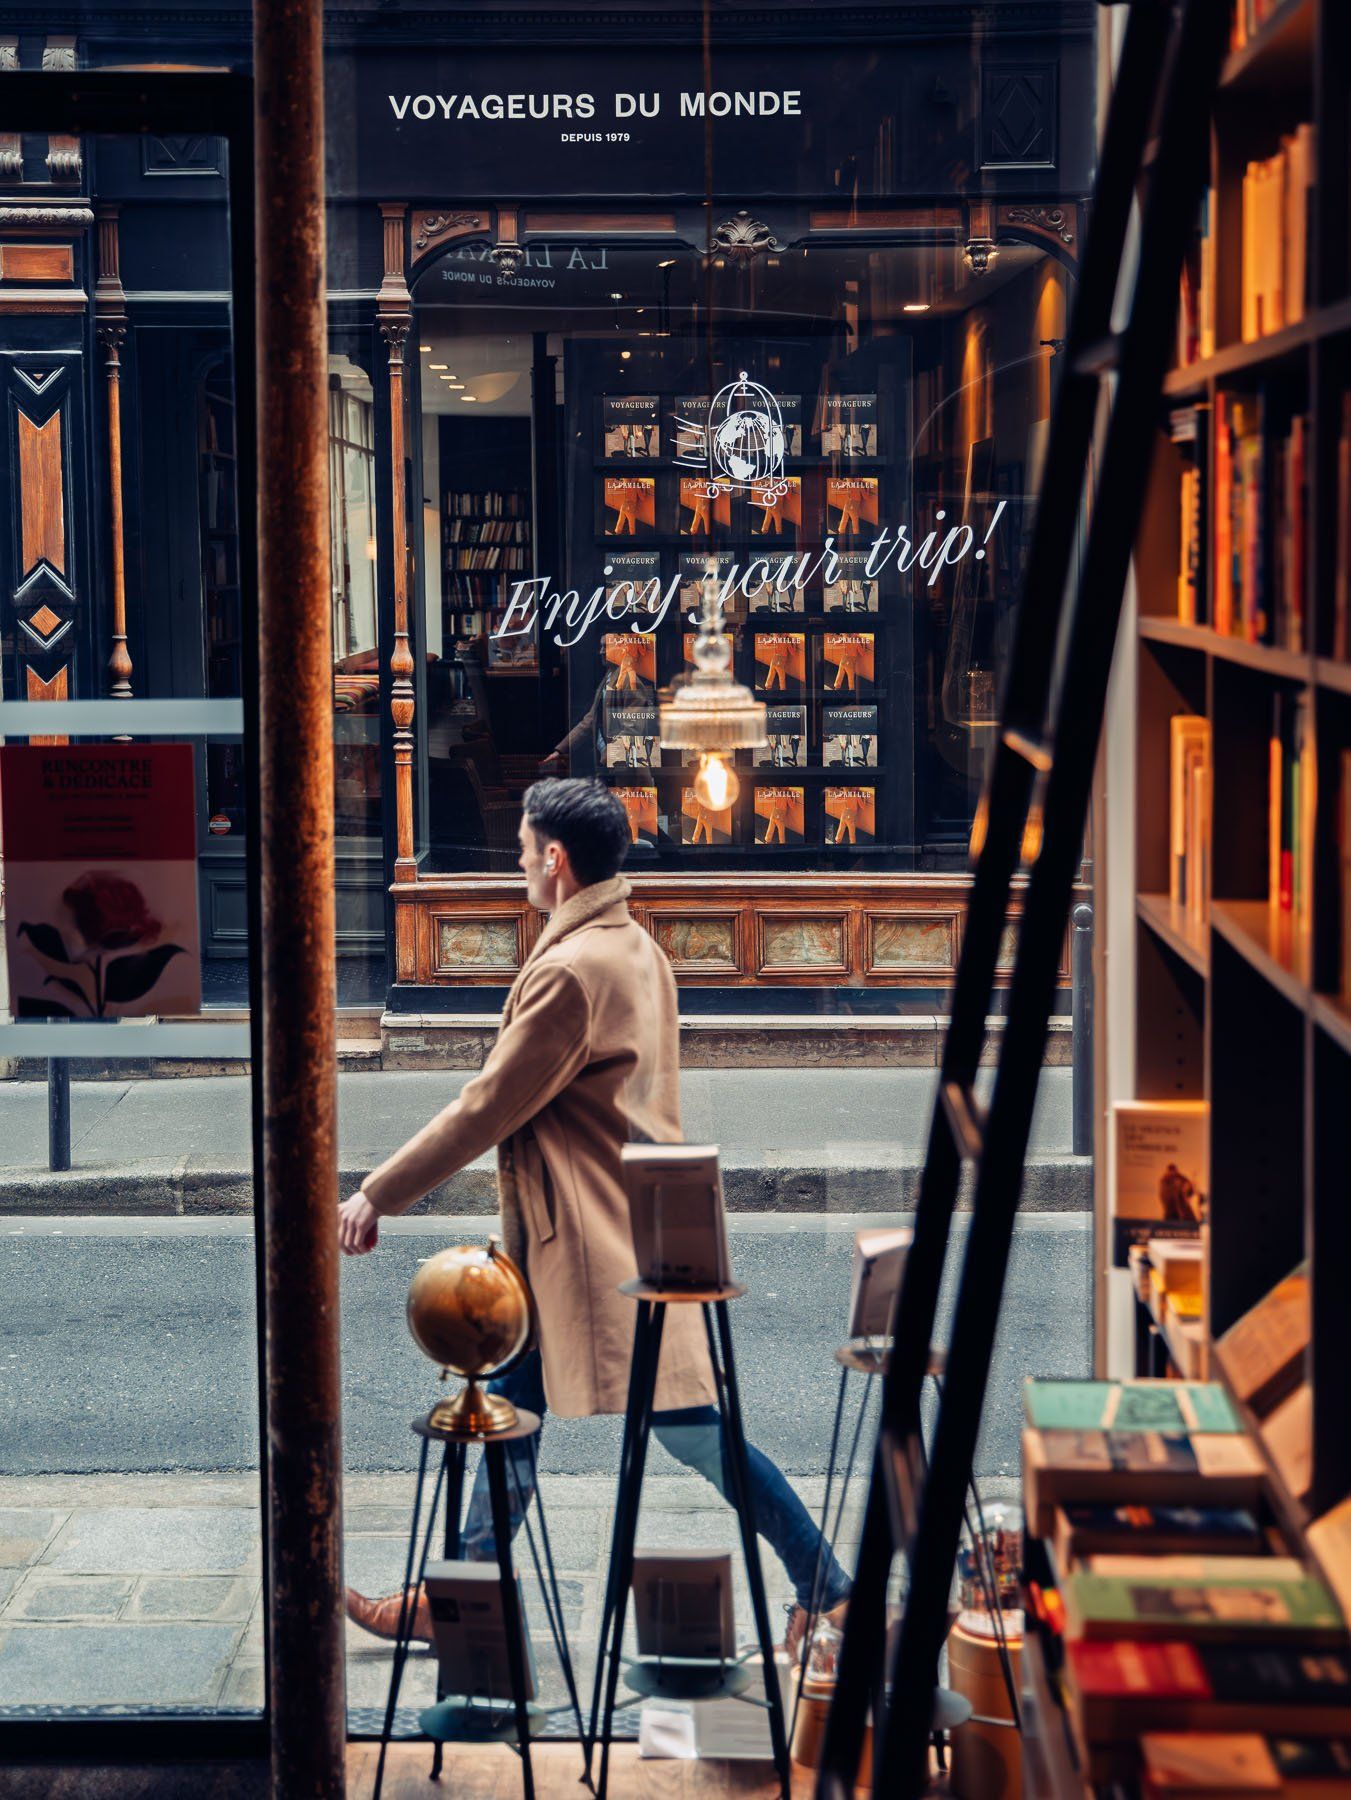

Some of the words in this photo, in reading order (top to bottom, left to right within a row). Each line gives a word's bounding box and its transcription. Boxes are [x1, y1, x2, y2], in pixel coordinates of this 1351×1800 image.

[388, 94, 596, 120] VOYAGEURS
[615, 92, 660, 118] DU
[680, 90, 802, 117] MONDE
[561, 133, 602, 142] DEPUIS
[605, 133, 630, 142] 1979
[610, 401, 655, 409] VOYAGEURS
[827, 400, 872, 408] VOYAGEURS
[489, 565, 682, 647] Enjoy
[688, 537, 843, 625] your
[864, 500, 1008, 587] trip!
[612, 712, 655, 720] VOYAGEURS
[762, 711, 801, 719] OYAGEURS
